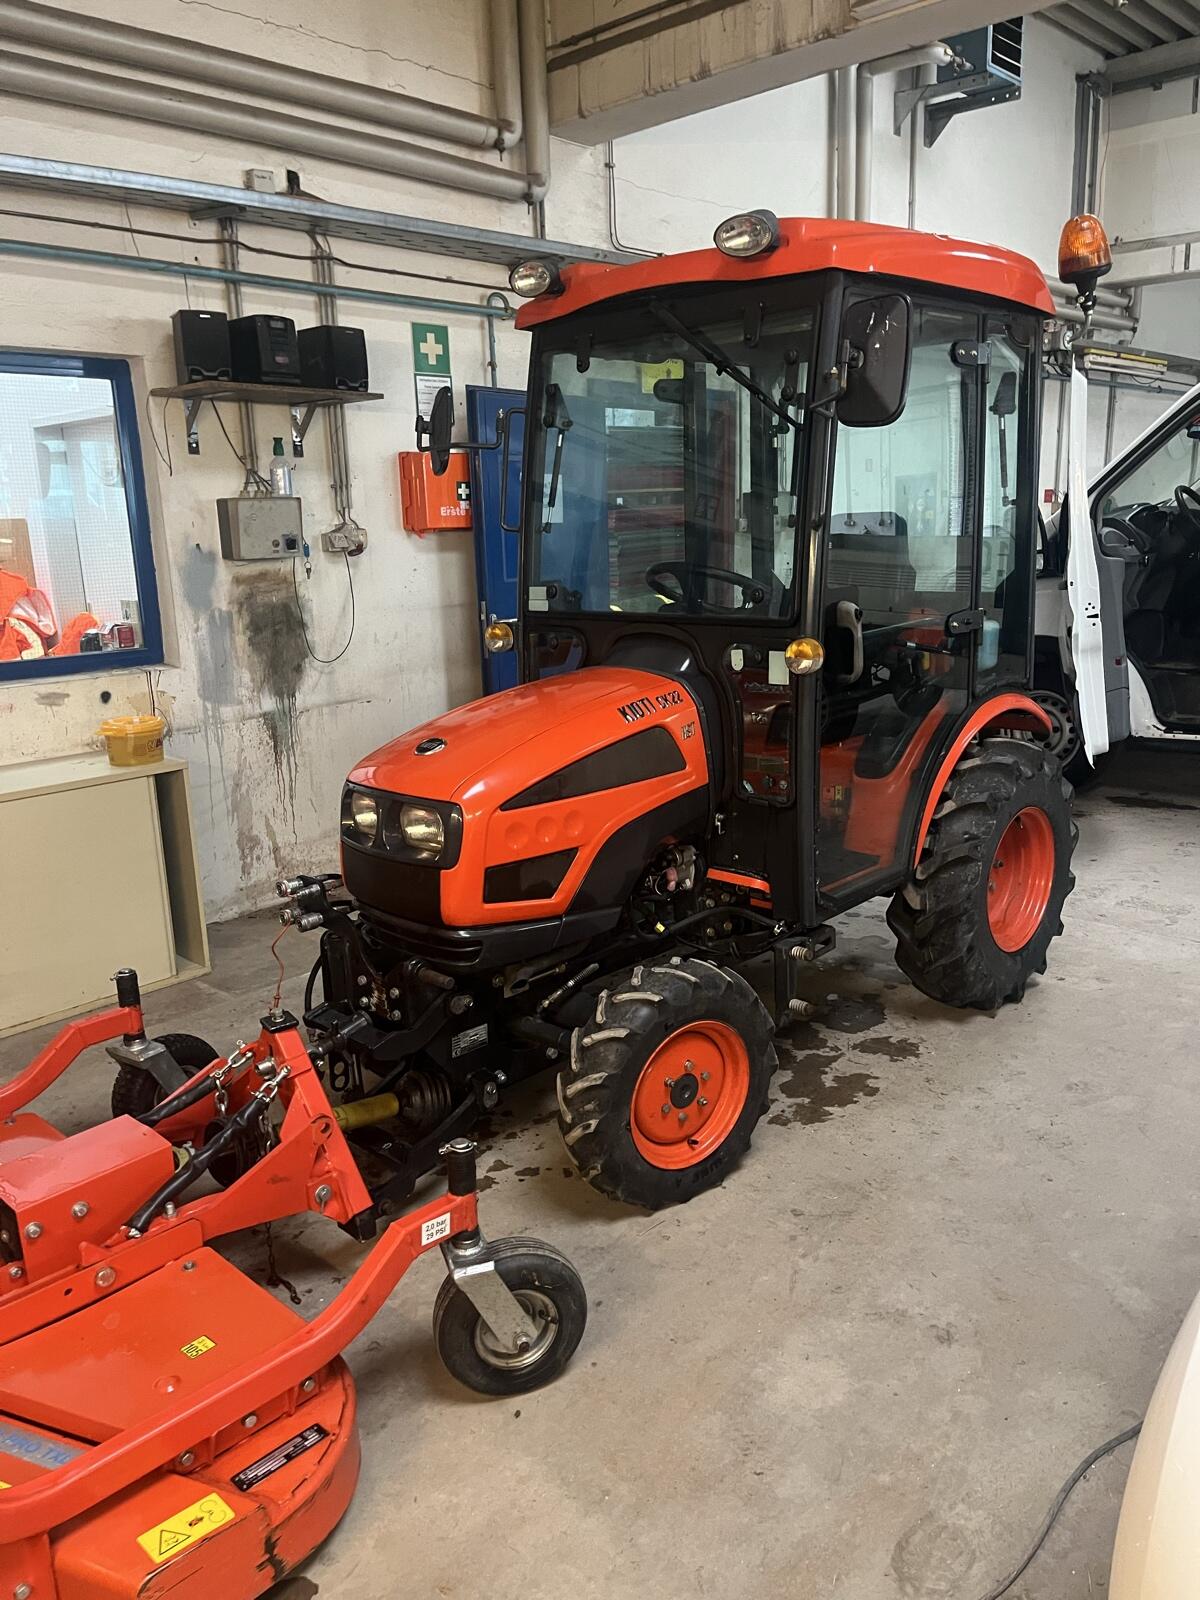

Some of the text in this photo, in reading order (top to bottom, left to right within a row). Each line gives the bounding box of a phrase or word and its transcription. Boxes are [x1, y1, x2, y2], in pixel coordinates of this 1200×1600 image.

[617, 697, 657, 724] KIOTI
[436, 1218, 447, 1228] bar
[426, 1232, 434, 1241] 29
[183, 1343, 203, 1357] 105
